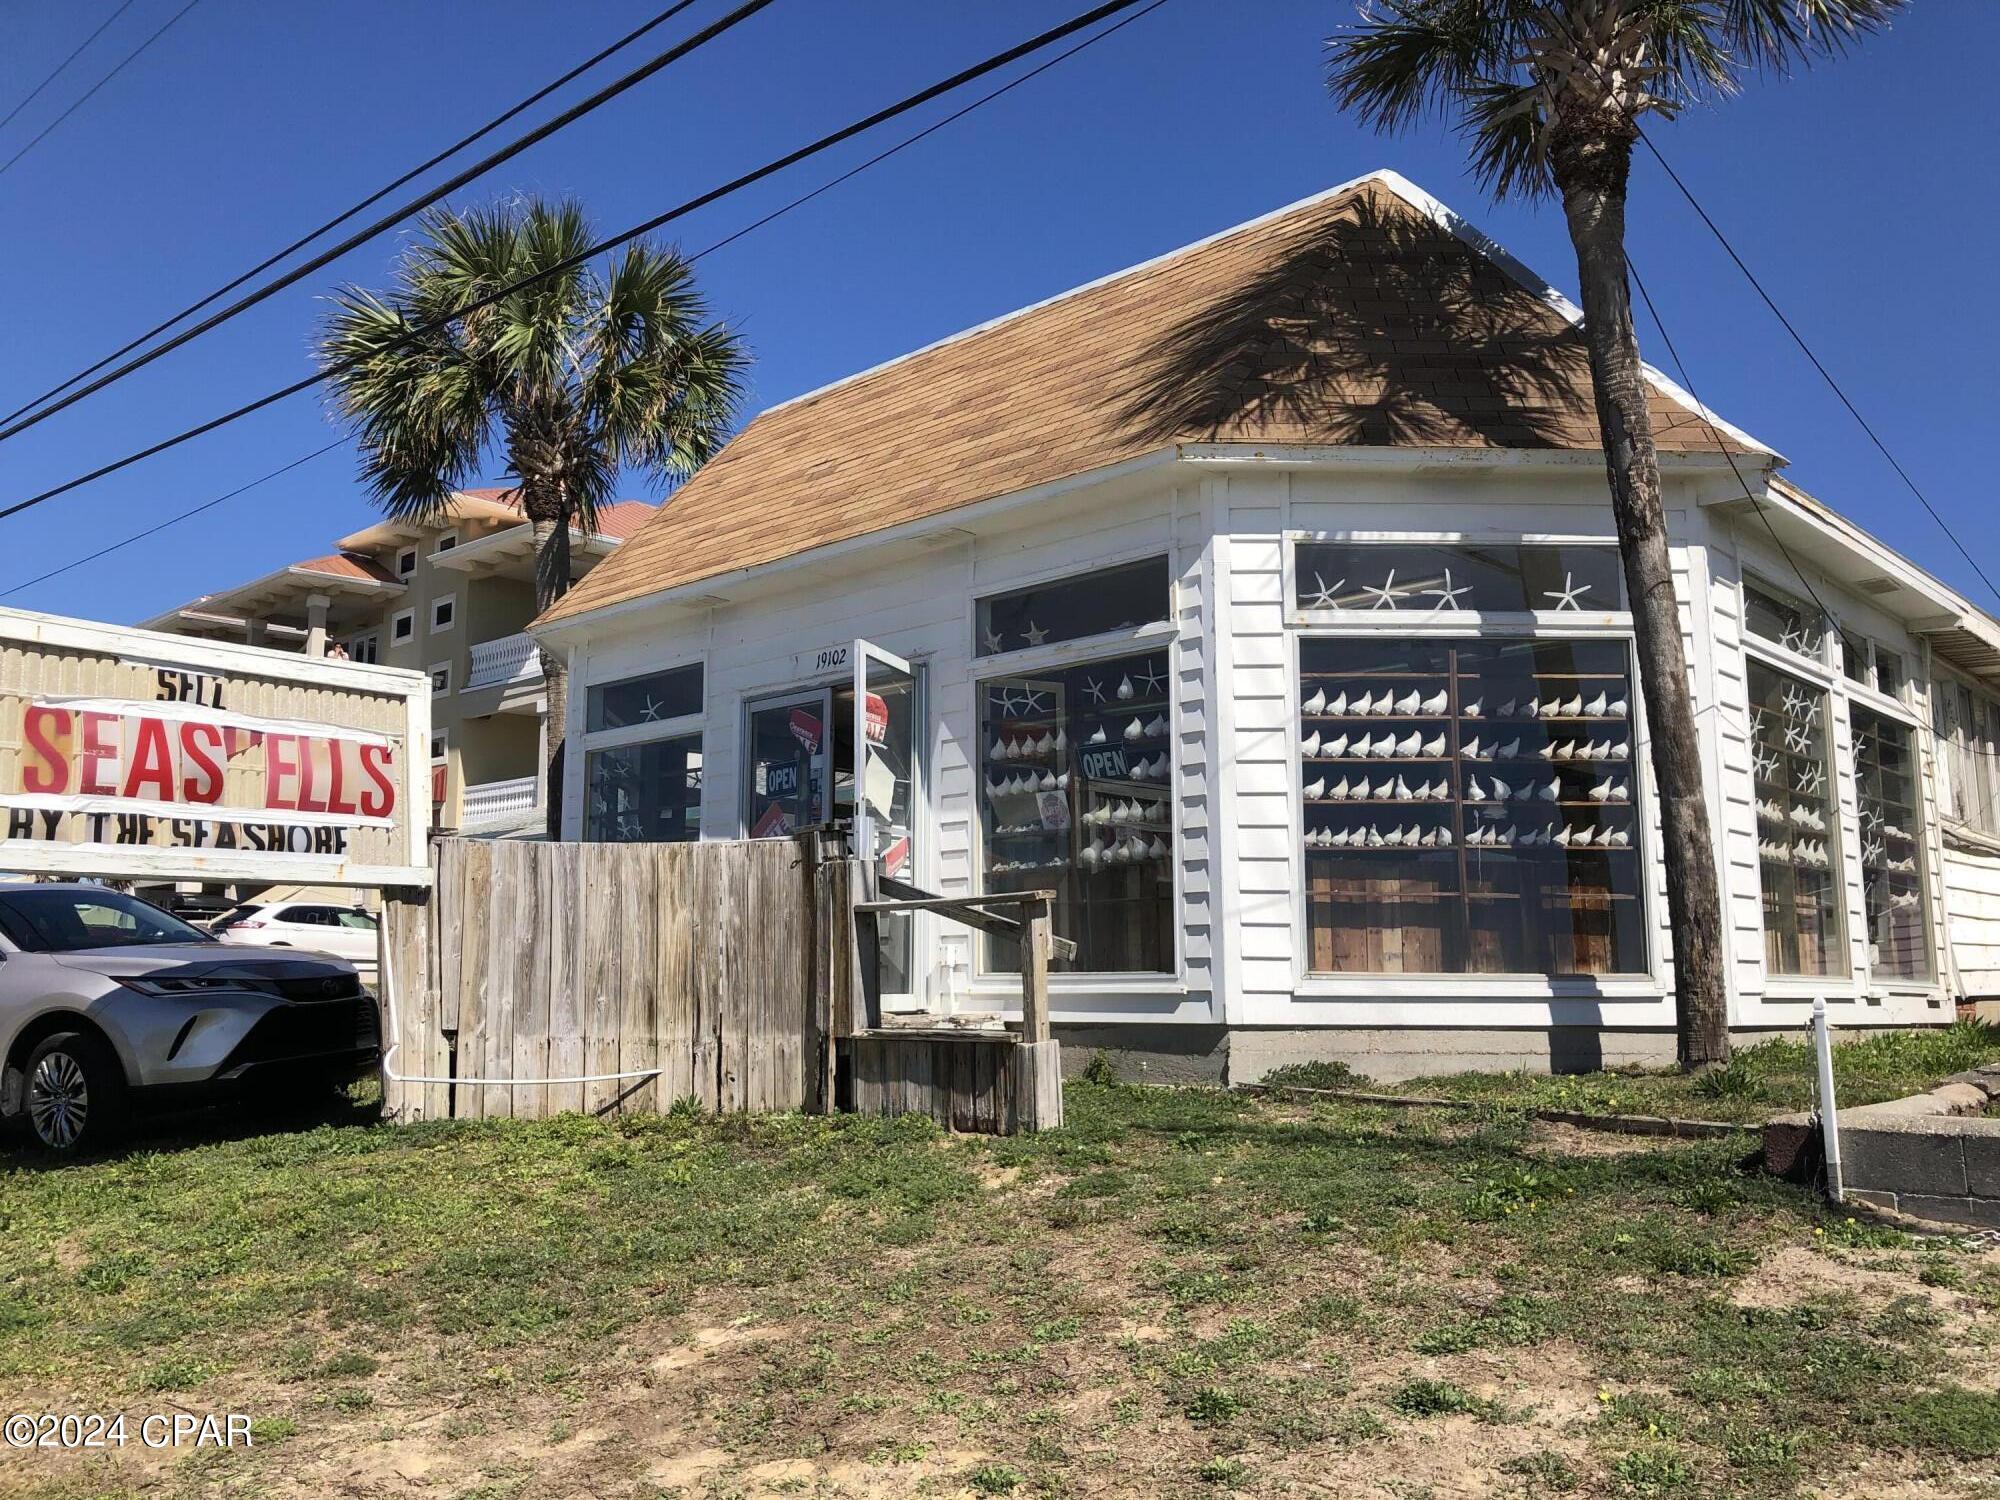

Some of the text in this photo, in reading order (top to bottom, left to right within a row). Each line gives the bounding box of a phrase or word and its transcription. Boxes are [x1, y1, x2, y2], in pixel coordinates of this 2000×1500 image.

[816, 648, 847, 671] 19102
[156, 669, 227, 710] SELL
[866, 721, 887, 743] ALE
[23, 706, 394, 818] SEASELLS
[1083, 750, 1128, 779] OPEN
[768, 766, 797, 791] OPEN
